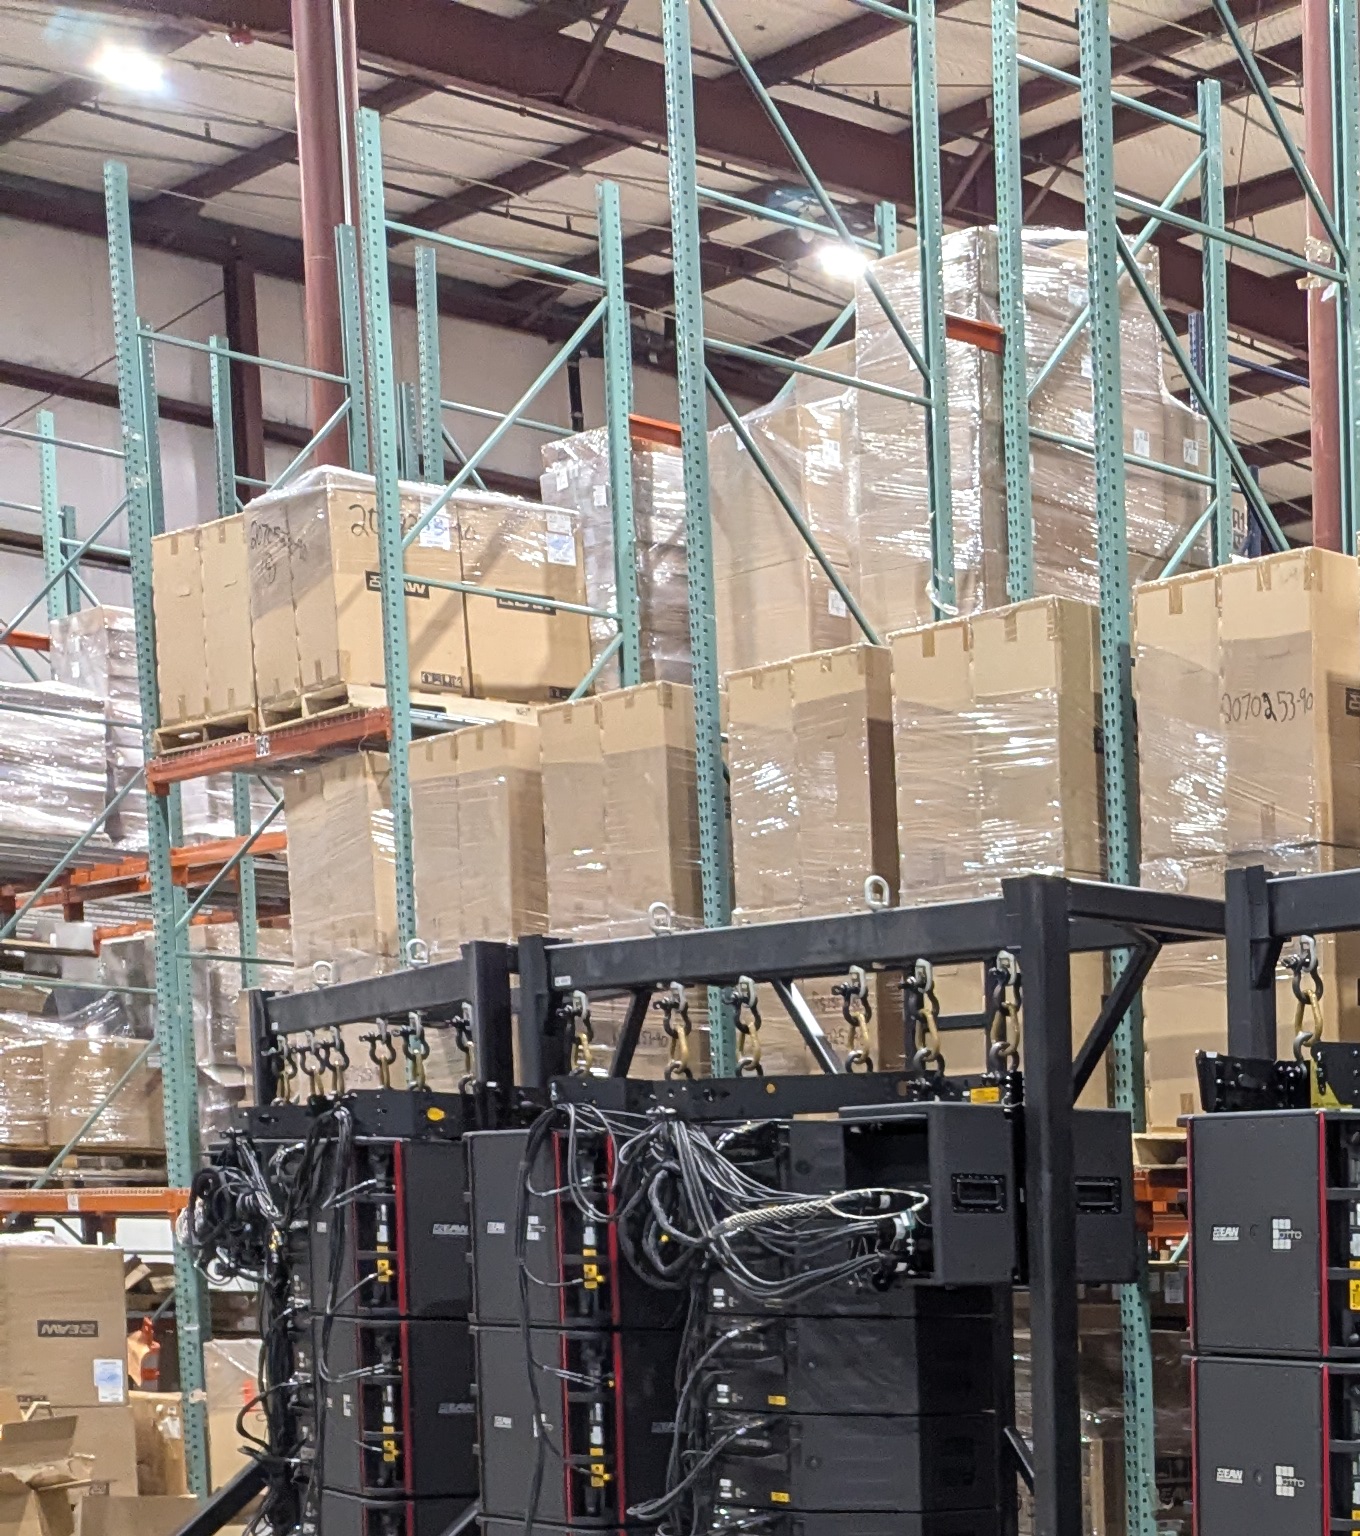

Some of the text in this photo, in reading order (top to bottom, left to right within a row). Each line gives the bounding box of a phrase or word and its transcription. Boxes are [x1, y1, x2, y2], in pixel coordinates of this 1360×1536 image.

[1221, 1227, 1240, 1238] EAW
[1278, 1229, 1303, 1240] otto
[1225, 1469, 1243, 1480] EAW
